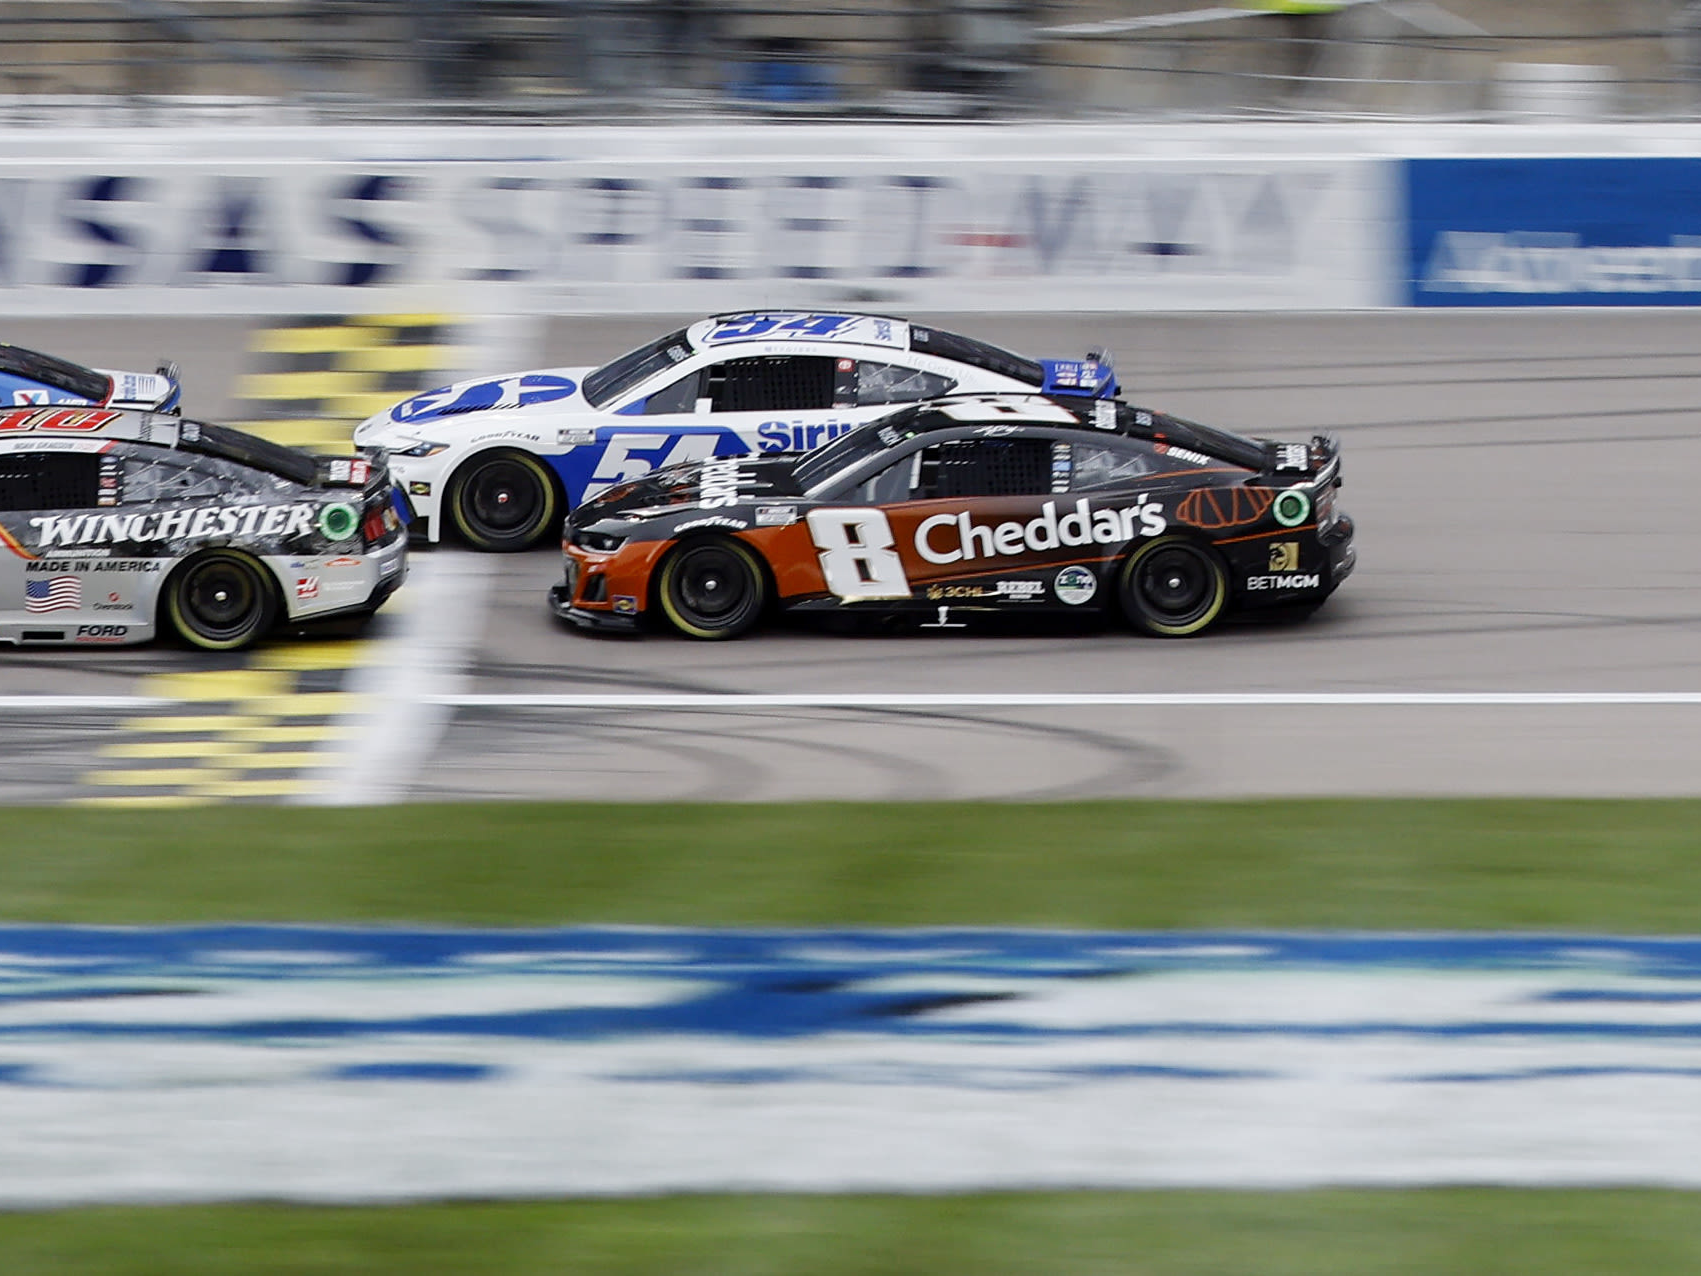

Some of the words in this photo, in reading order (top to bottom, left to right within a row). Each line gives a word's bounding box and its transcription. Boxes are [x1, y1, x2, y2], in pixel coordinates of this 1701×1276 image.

[463, 174, 1323, 280] SPEEDWAY
[705, 314, 865, 344] 54
[471, 430, 540, 443] GOODYEAR
[29, 503, 314, 549] WINCHESTER
[673, 515, 748, 533] GOODYEAR
[914, 492, 1167, 565] Cheddar's
[806, 507, 913, 598] 8
[26, 561, 70, 572] MADE
[74, 561, 90, 572] IN
[93, 561, 161, 572] AMERICA
[1247, 575, 1320, 590] BETMGM
[77, 625, 128, 637] FORD
